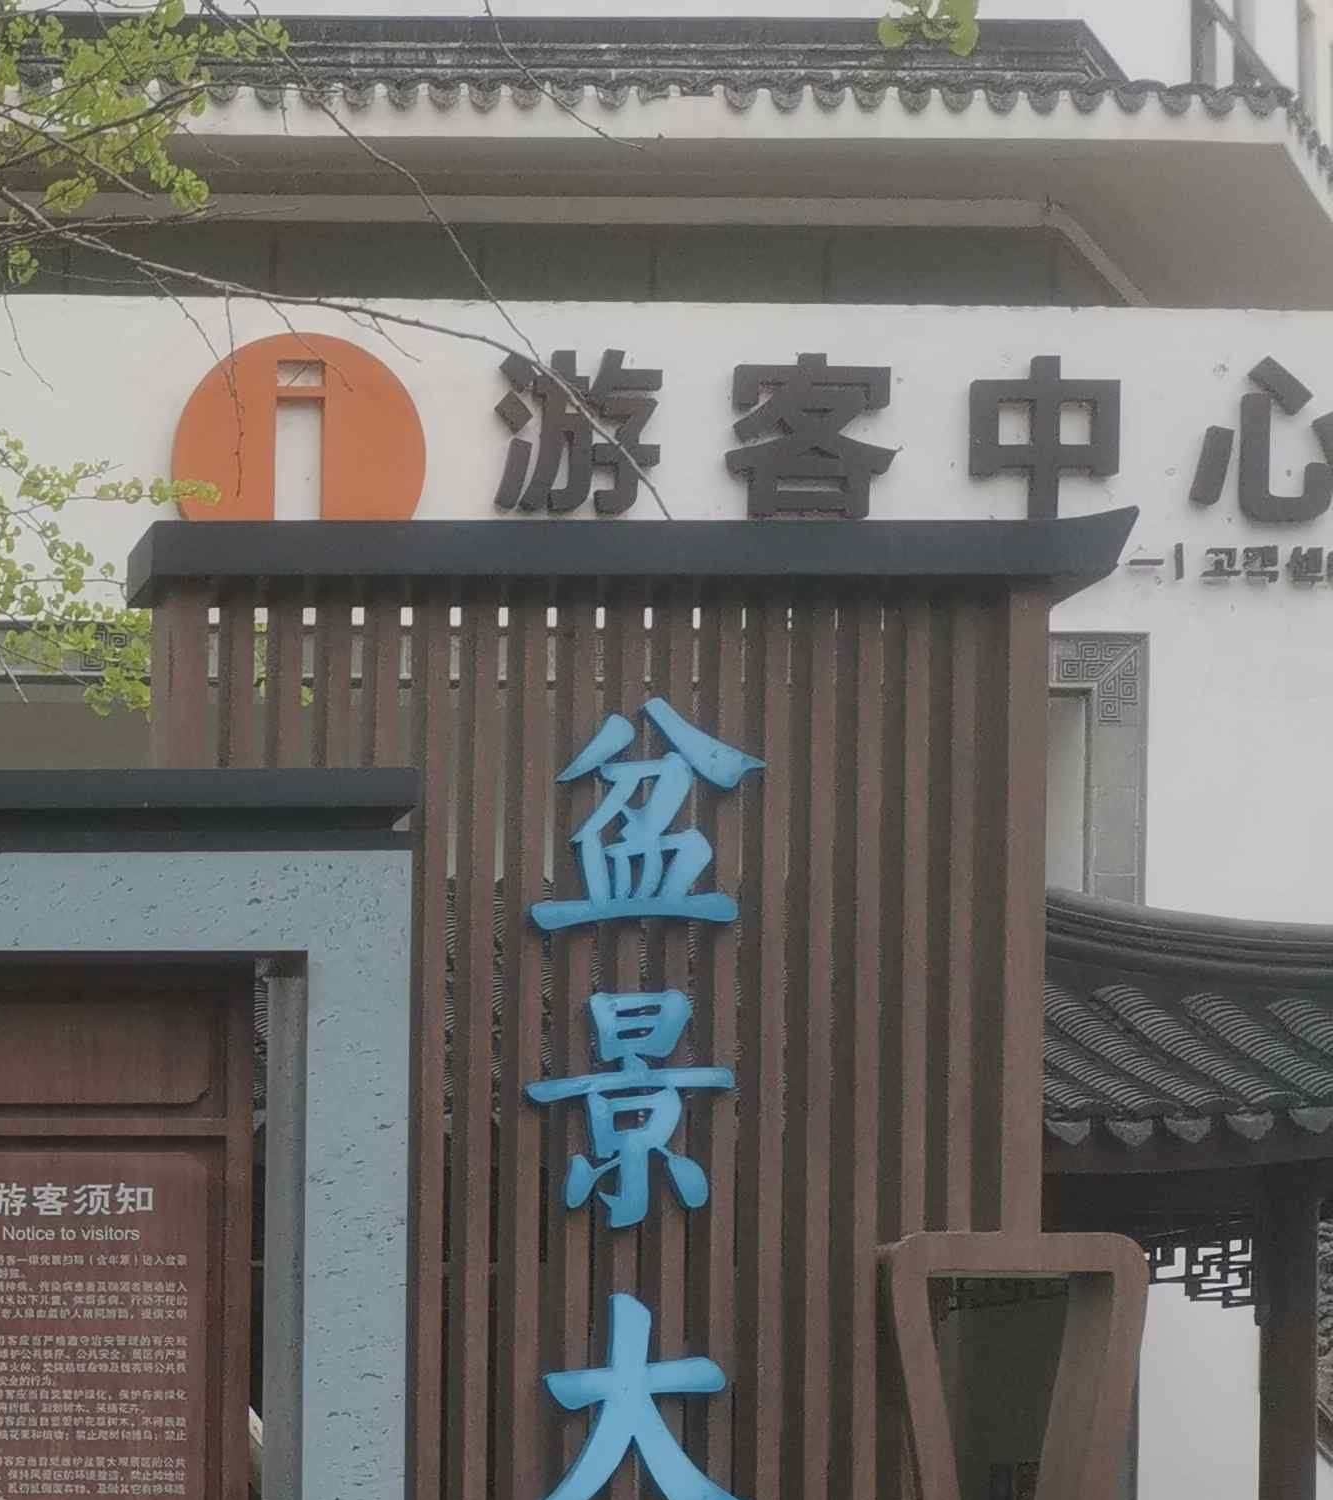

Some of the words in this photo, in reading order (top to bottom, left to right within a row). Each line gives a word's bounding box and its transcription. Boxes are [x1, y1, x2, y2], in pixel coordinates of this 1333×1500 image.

[494, 349, 1333, 523] 游客中心
[1200, 544, 1333, 584] 고객센
[2, 1223, 56, 1242] Notice
[59, 1225, 77, 1242] to
[80, 1224, 142, 1242] visitors
